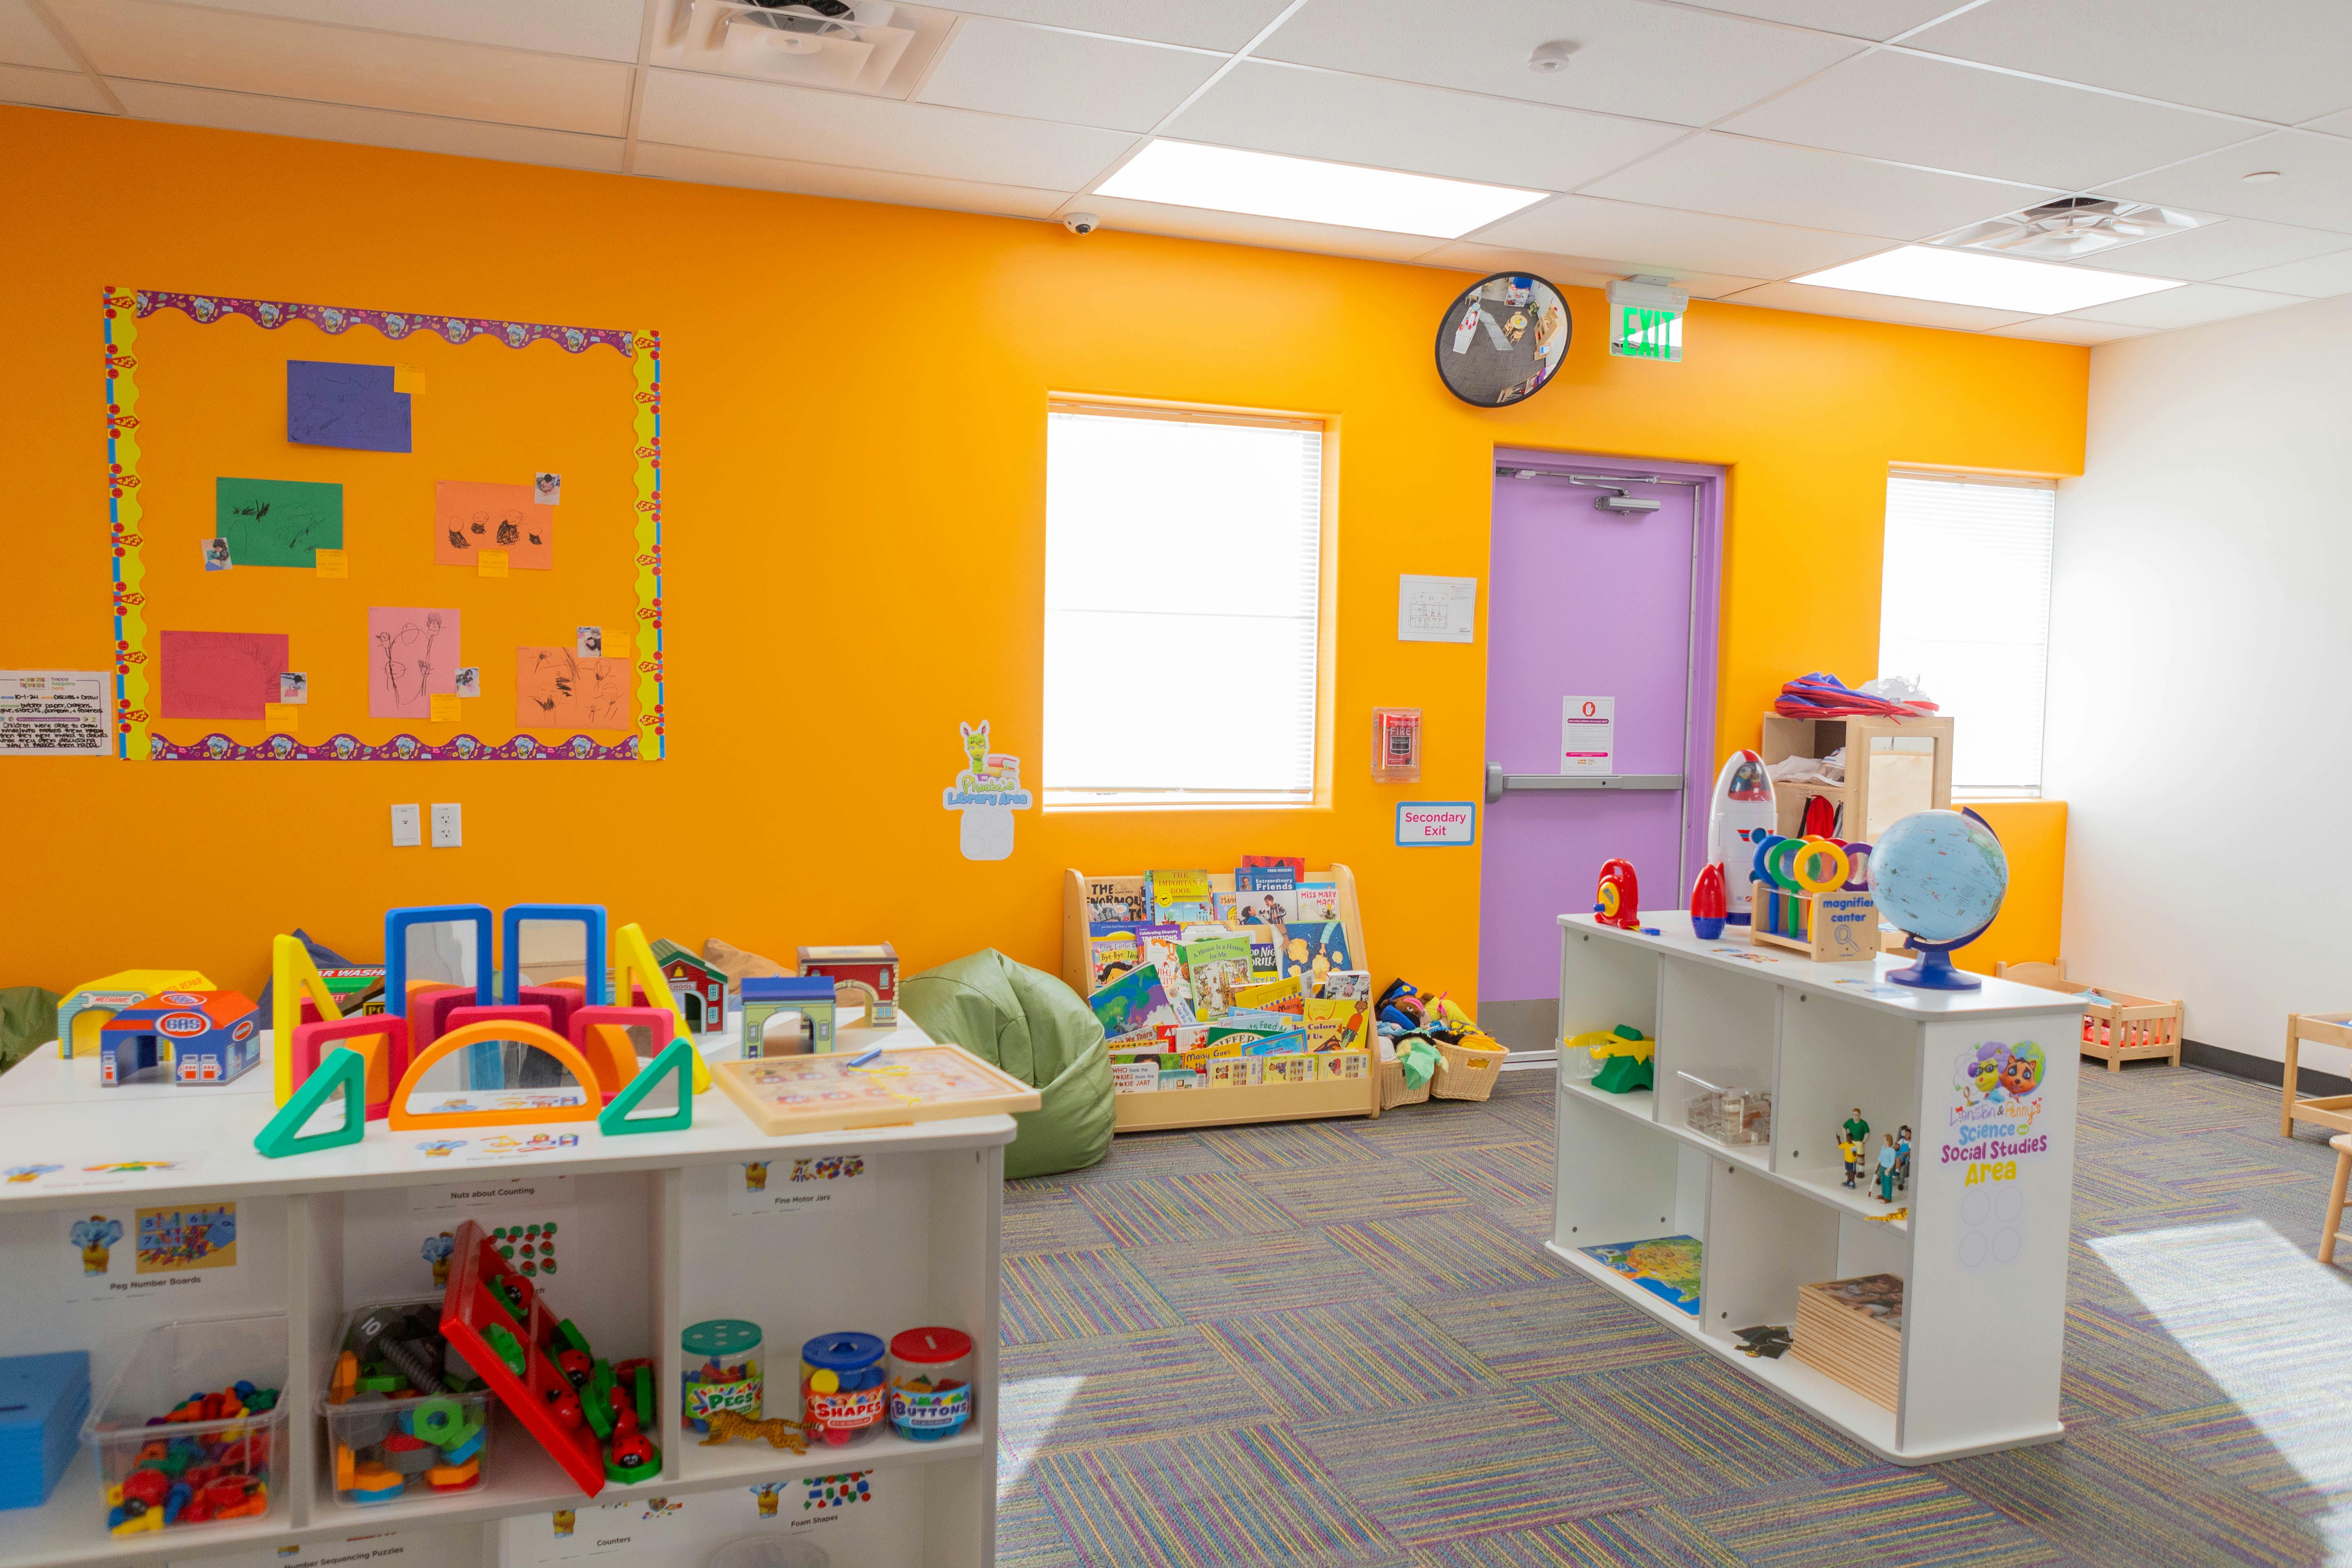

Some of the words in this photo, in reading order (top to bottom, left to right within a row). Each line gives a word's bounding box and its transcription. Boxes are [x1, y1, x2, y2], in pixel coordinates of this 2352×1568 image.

[1623, 307, 1675, 359] EXIT
[1390, 727, 1411, 735] FIRE
[961, 775, 1015, 795] Phoebe's
[947, 792, 997, 806] Library
[998, 793, 1027, 805] Area
[1405, 812, 1466, 824] Secondary
[1425, 826, 1446, 836] Exit
[1091, 884, 1114, 895] THE
[1830, 912, 1866, 922] center
[1100, 951, 1124, 961] Bye-Bye
[1198, 946, 1215, 956] House
[1227, 943, 1244, 952] House
[179, 977, 203, 991] REPAIR
[1179, 1000, 1190, 1016] Wheels
[166, 1019, 200, 1032] GAS
[1260, 1021, 1278, 1031] Feed
[1136, 1031, 1153, 1040] There
[1186, 1053, 1210, 1062] Maisy
[1997, 1105, 2004, 1116] &
[2005, 1100, 2041, 1125] Penny's
[1958, 1124, 2015, 1146] Science
[1941, 1142, 1986, 1164] Social
[1990, 1135, 2047, 1160] Studies
[1964, 1160, 2017, 1187] Area
[498, 1187, 535, 1196] Counting
[130, 1279, 167, 1289] Number
[170, 1276, 201, 1285] Boards
[708, 1392, 754, 1409] PEGS
[816, 1401, 881, 1417] SHAPES
[896, 1400, 967, 1417] BUTTONS
[791, 1519, 811, 1527] Foam
[813, 1515, 838, 1524] Shapes
[596, 1536, 631, 1547] Counters
[320, 1553, 370, 1566] Sequencing
[372, 1547, 403, 1557] Puzzles
